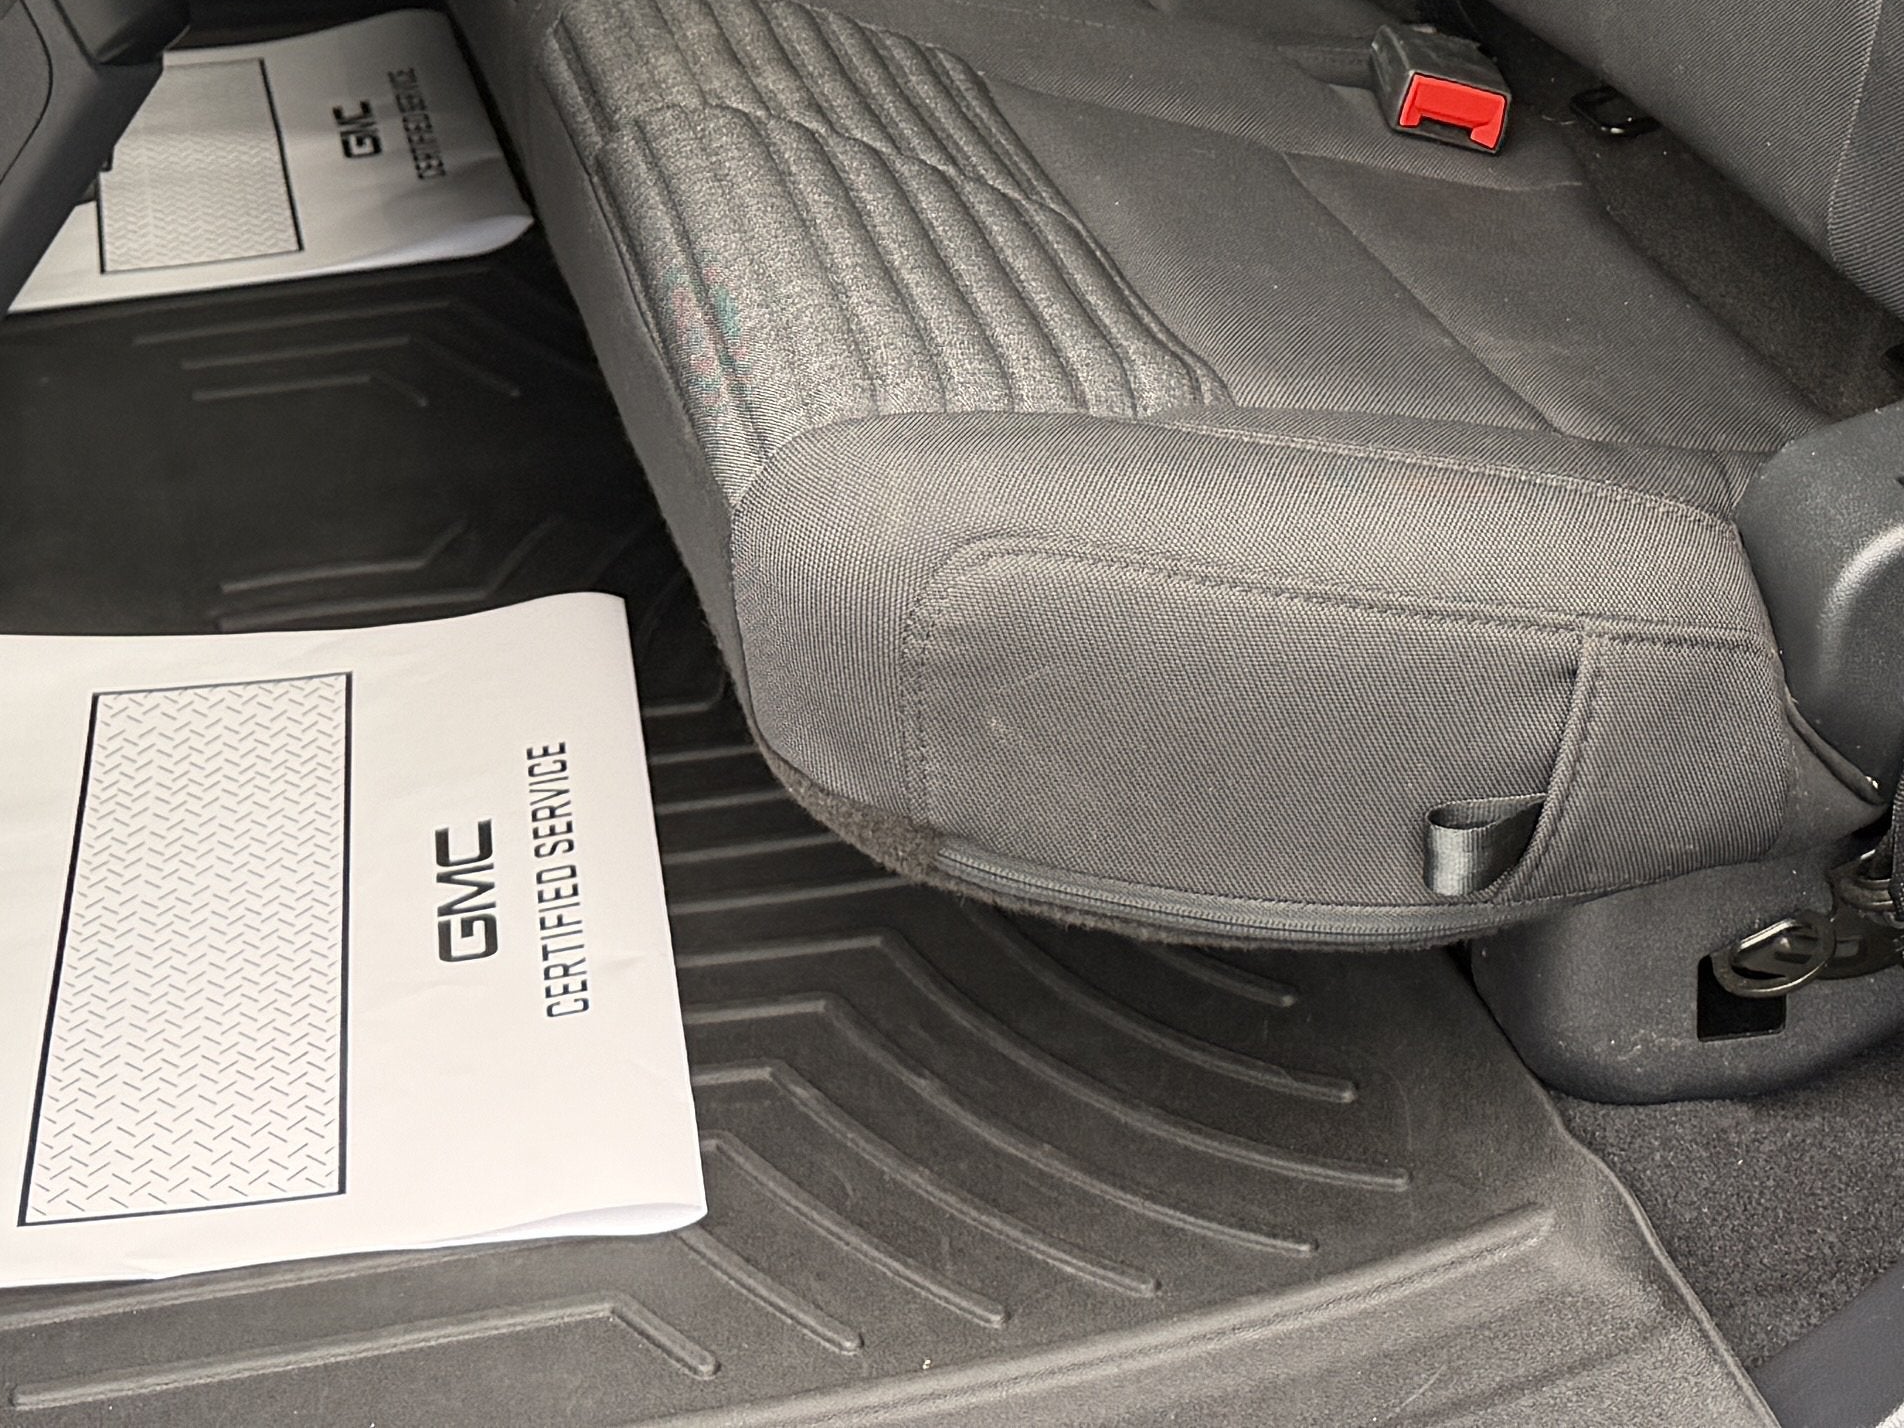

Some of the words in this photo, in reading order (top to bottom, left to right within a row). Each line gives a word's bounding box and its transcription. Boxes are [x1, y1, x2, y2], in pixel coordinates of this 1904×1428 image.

[525, 742, 575, 858] SERVICE
[433, 818, 500, 963] GMC
[535, 864, 591, 1019] CERTIFIED
